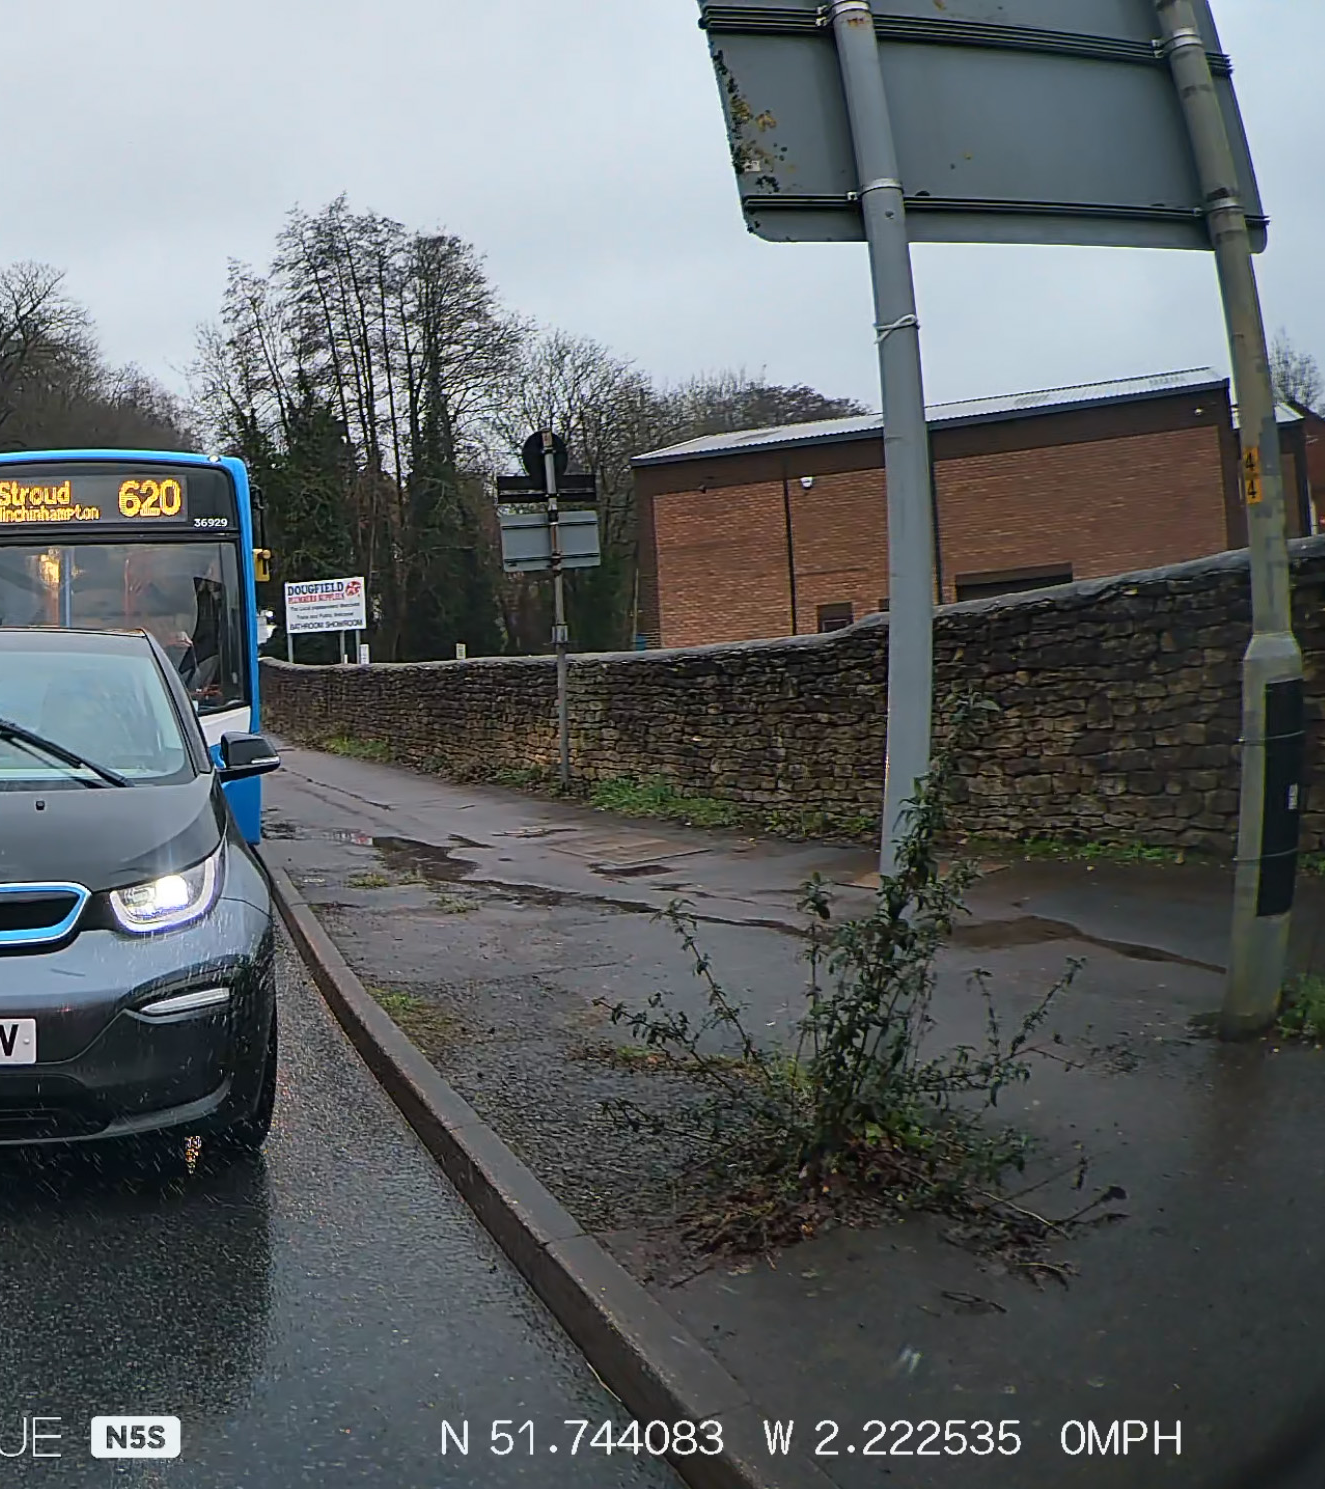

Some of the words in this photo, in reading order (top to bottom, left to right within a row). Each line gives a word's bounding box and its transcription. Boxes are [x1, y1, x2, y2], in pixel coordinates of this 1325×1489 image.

[118, 478, 182, 518] 620
[193, 518, 228, 528] 36929
[287, 582, 344, 596] DOUGFIELD
